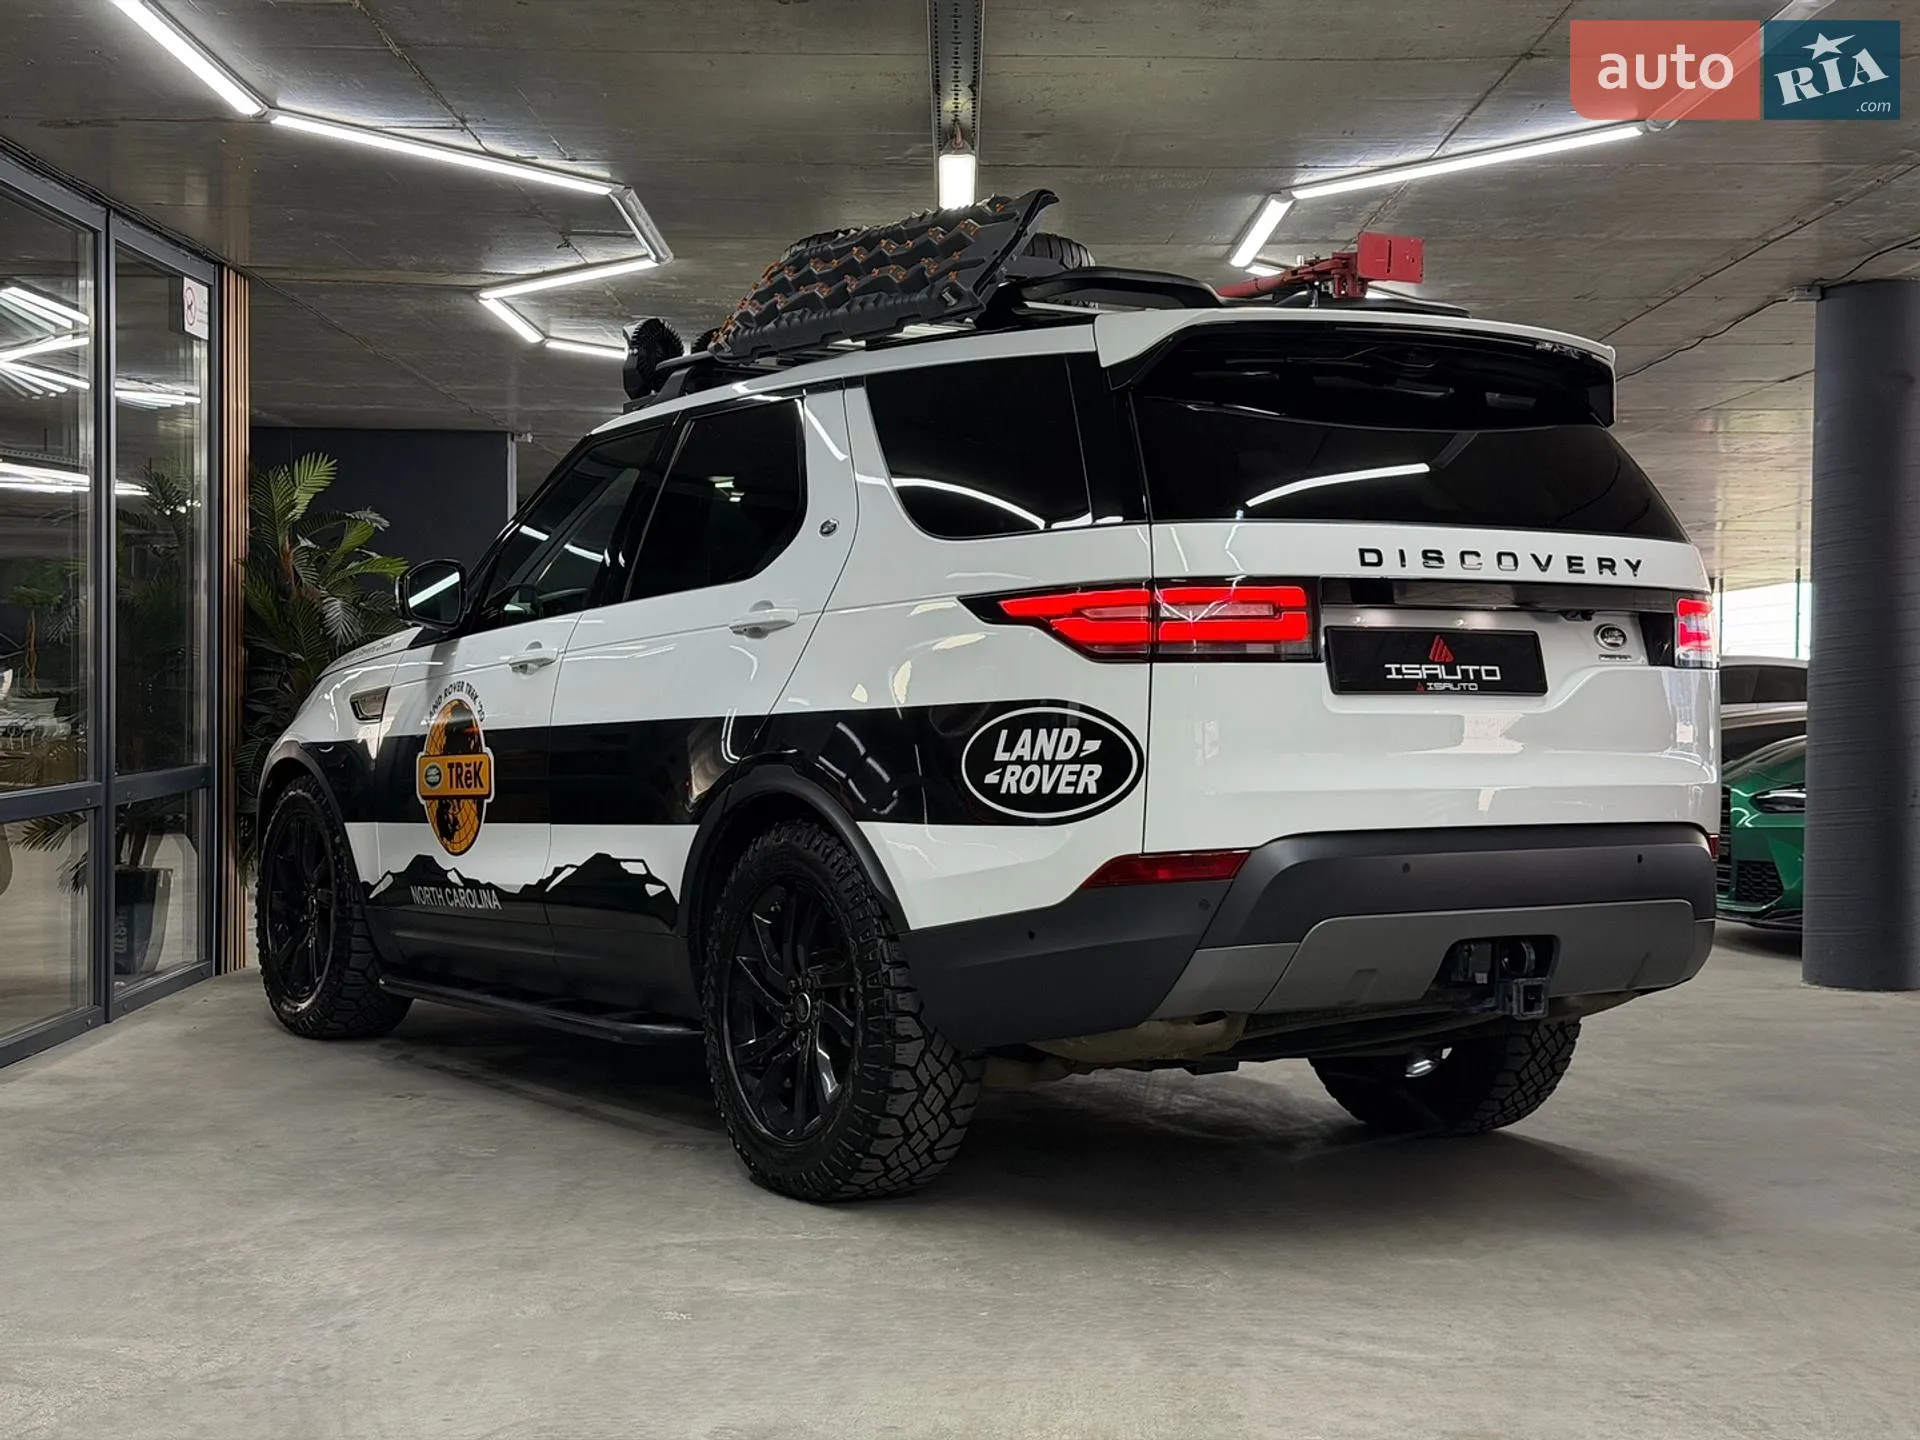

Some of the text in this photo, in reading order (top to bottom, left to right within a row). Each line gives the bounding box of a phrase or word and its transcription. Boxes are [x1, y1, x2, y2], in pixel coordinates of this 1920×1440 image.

[1357, 547, 1643, 578] DISCOVERY
[1384, 664, 1501, 681] ISAUTO
[444, 680, 465, 699] ROVER
[1426, 682, 1479, 691] ISAUTO
[993, 727, 1082, 762] LAND
[999, 763, 1103, 795] ROVER
[410, 885, 502, 910] NORTH CAROLINA
